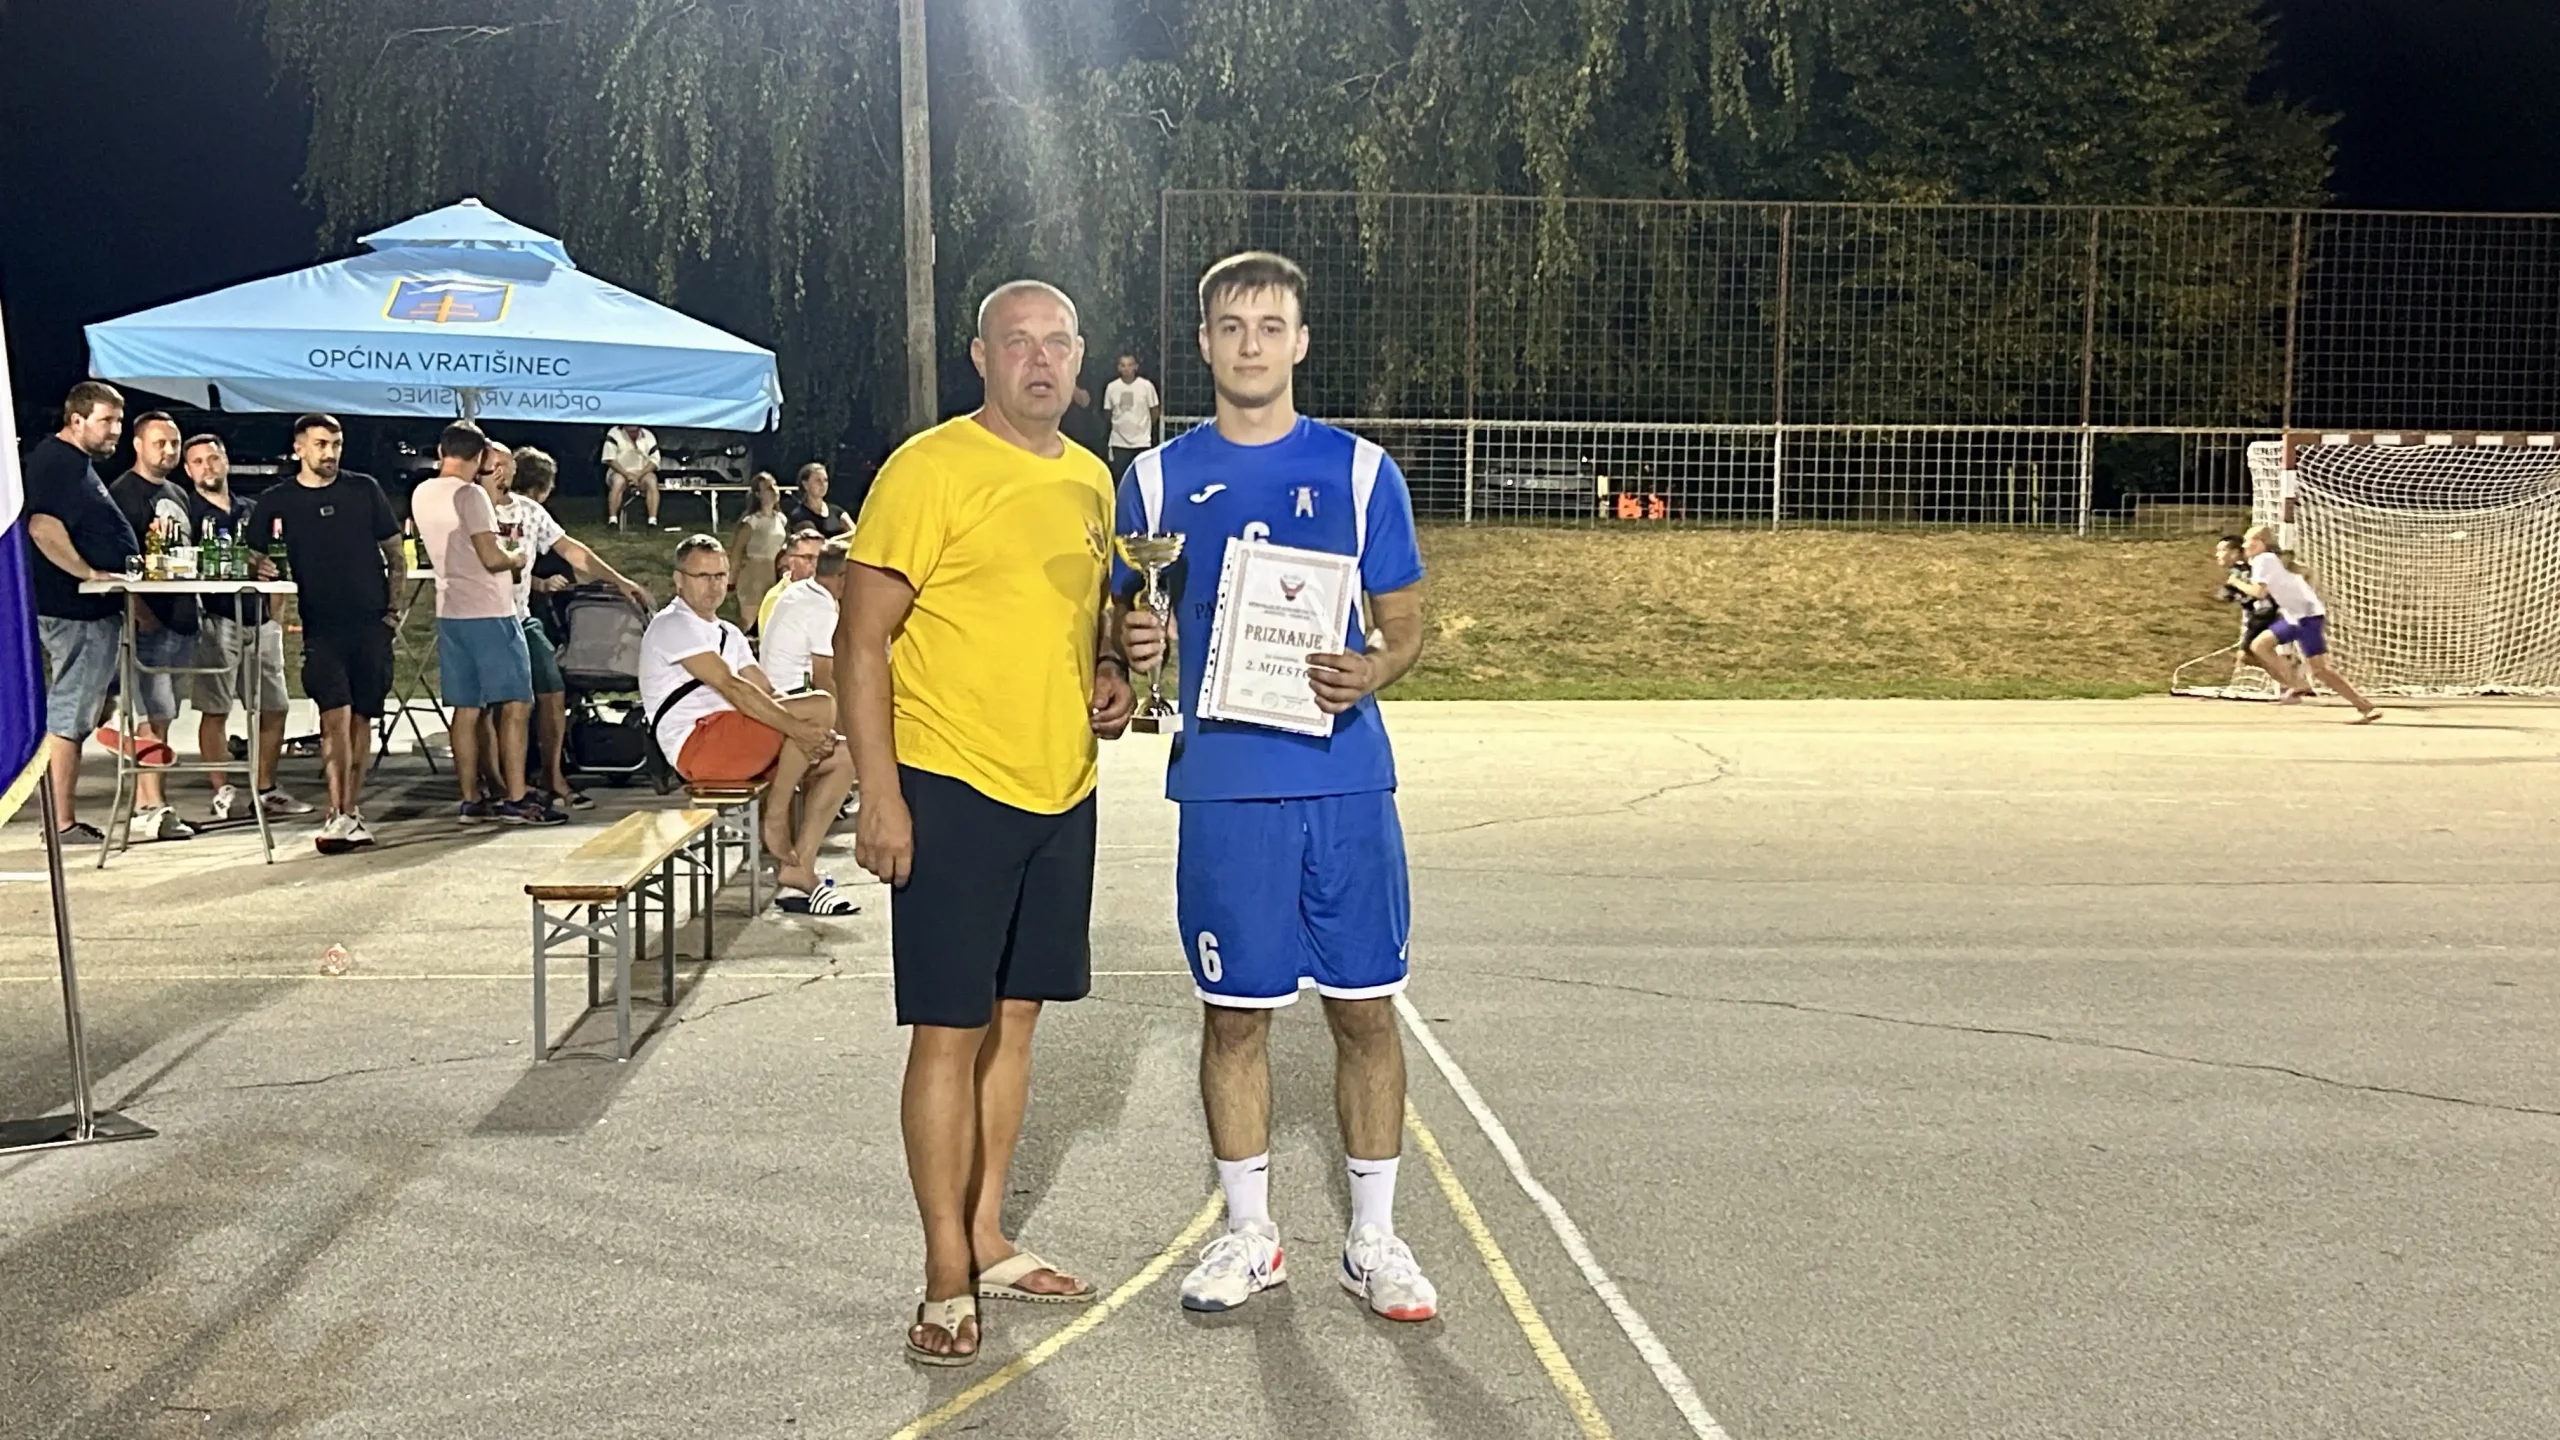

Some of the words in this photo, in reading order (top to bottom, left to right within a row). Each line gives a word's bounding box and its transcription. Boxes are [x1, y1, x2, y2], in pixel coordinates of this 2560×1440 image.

[308, 345, 412, 371] OPĆINA
[418, 350, 571, 377] VRATIŠINEC
[1244, 623, 1324, 650] PRIZNANJE
[1198, 931, 1223, 983] 6
